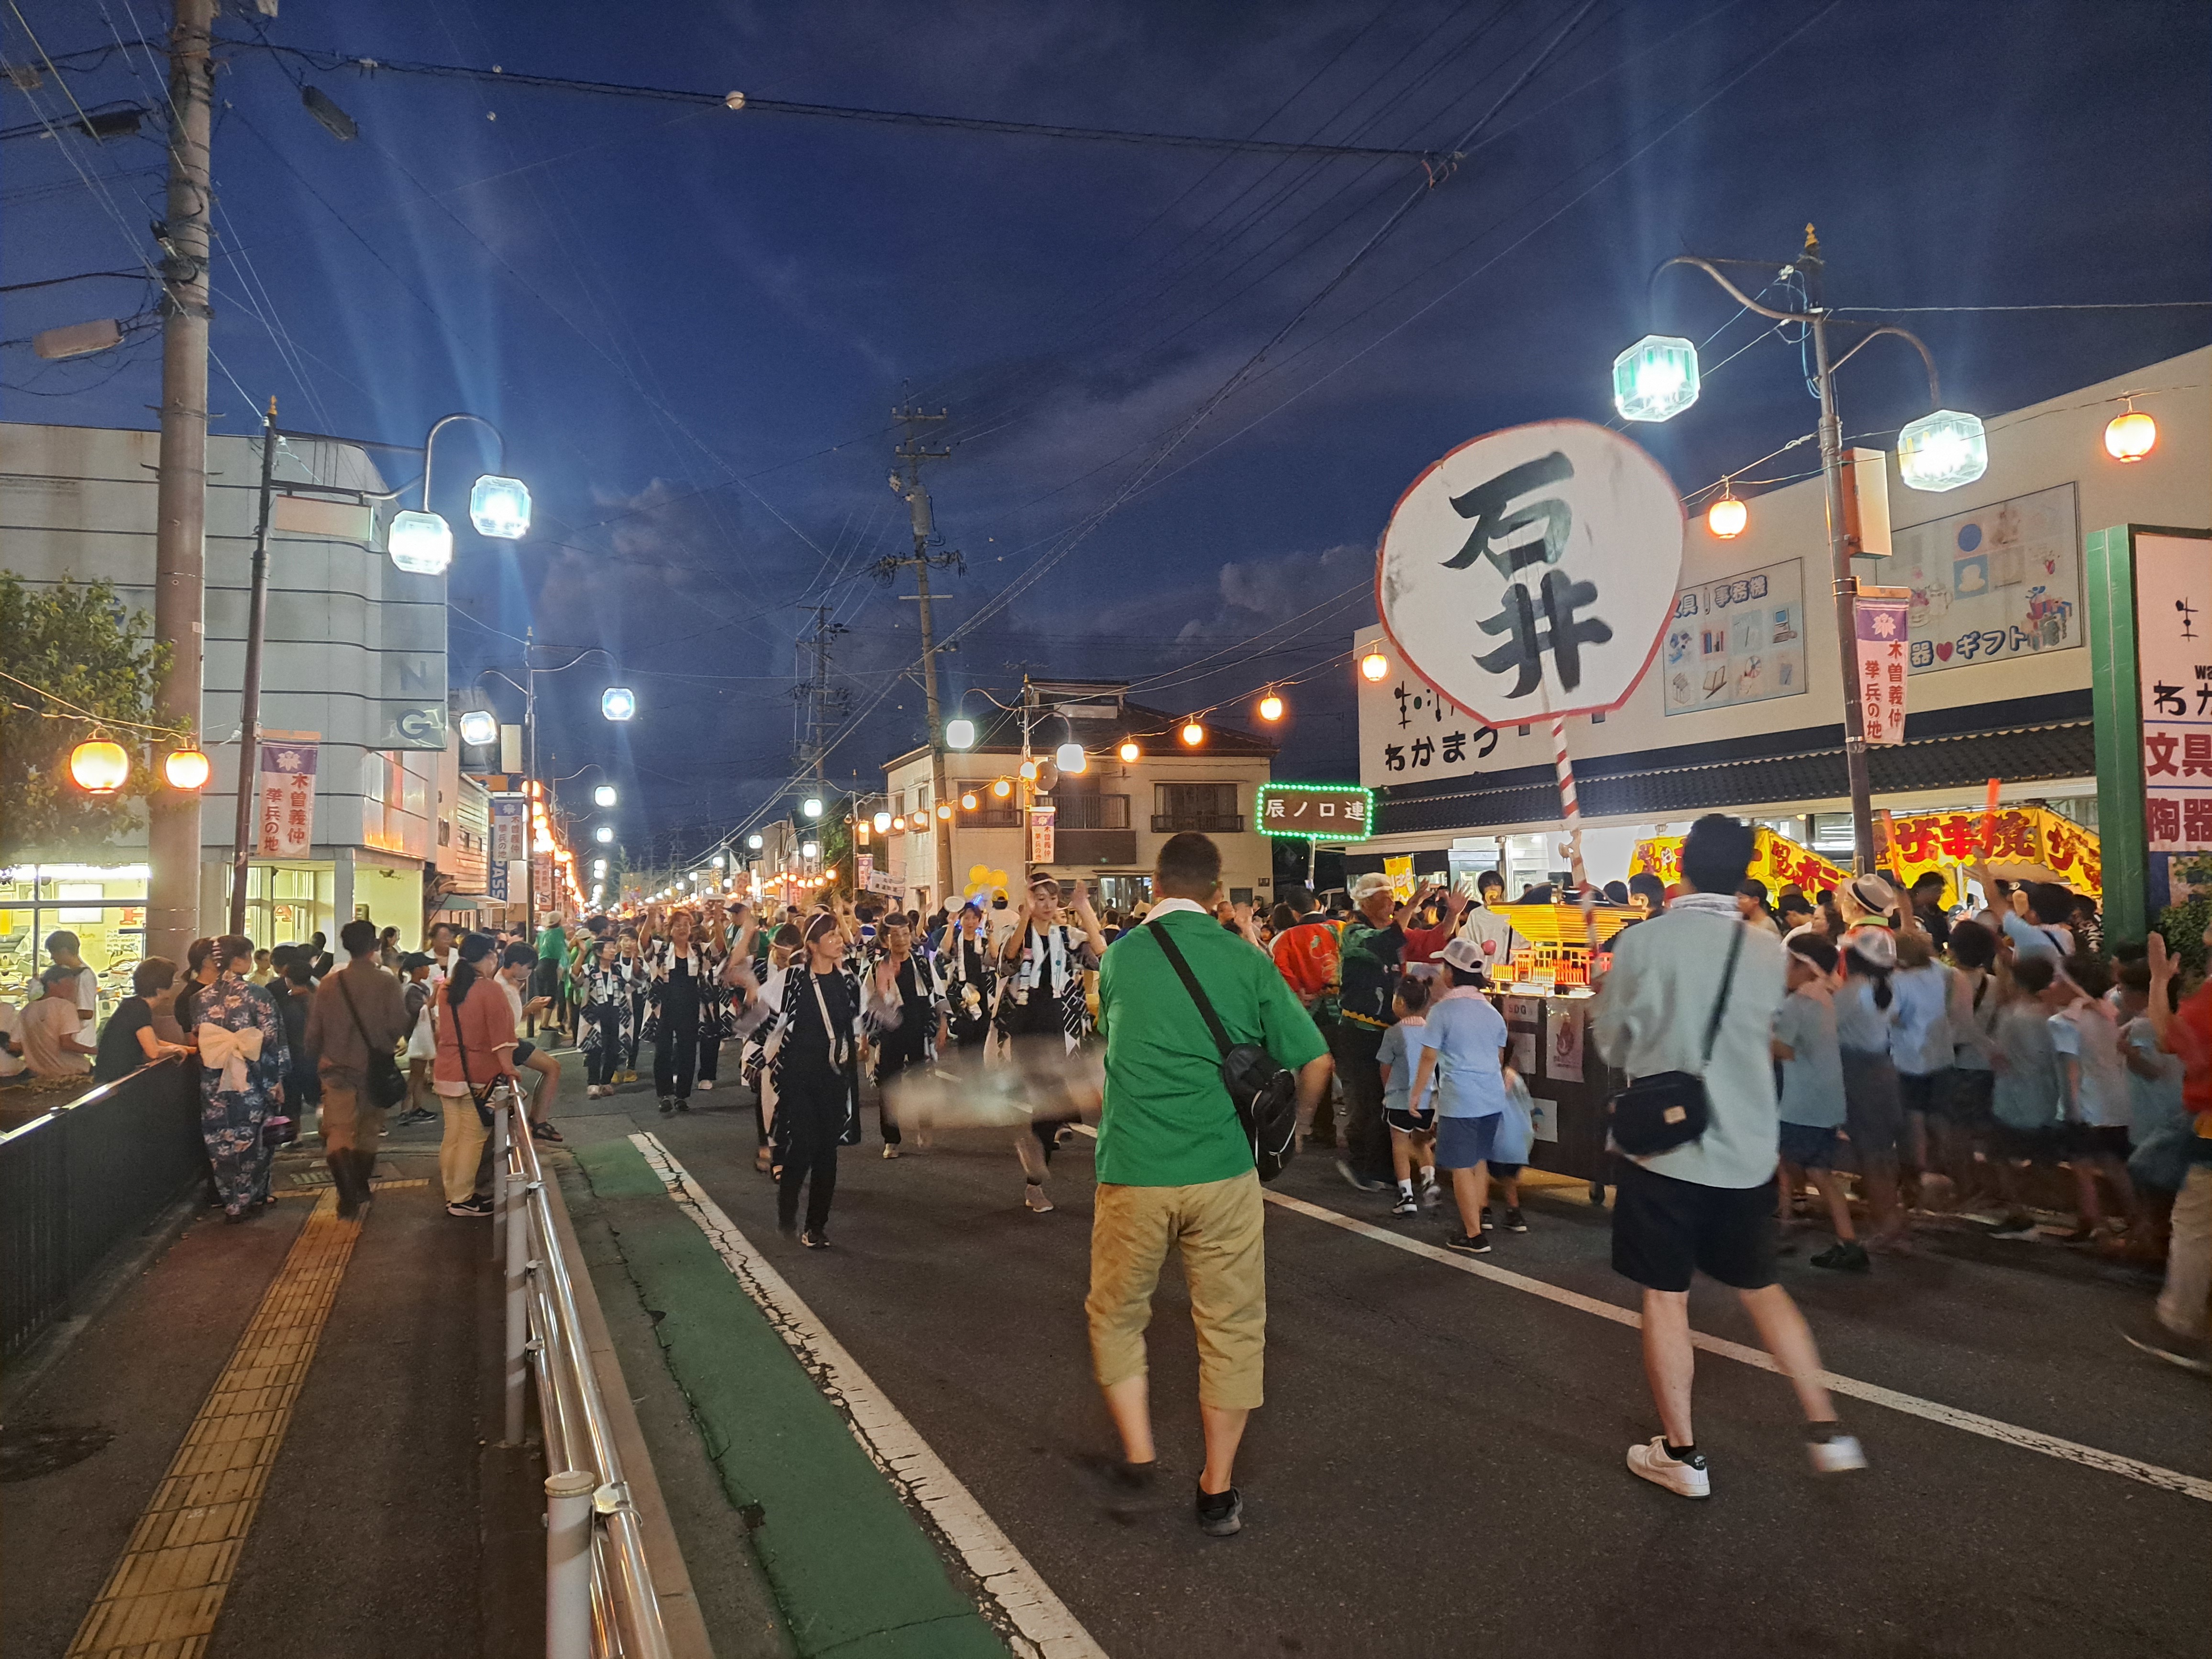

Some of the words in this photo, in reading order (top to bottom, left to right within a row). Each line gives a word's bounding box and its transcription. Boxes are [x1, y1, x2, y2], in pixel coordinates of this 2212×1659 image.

[1438, 451, 1613, 698] 石井
[1674, 594, 1698, 618] 具
[1714, 575, 1768, 608] 事務機
[1956, 626, 2028, 659] ギフト
[1865, 660, 1882, 739] 挙兵の地
[1888, 640, 1903, 728] 木曽義仲
[1385, 726, 1498, 772] わかまつ
[2146, 732, 2212, 777] 文具
[264, 787, 283, 852] 挙兵の地
[288, 773, 309, 844] 木曽義仲
[1265, 799, 1365, 821] 辰ノ口連
